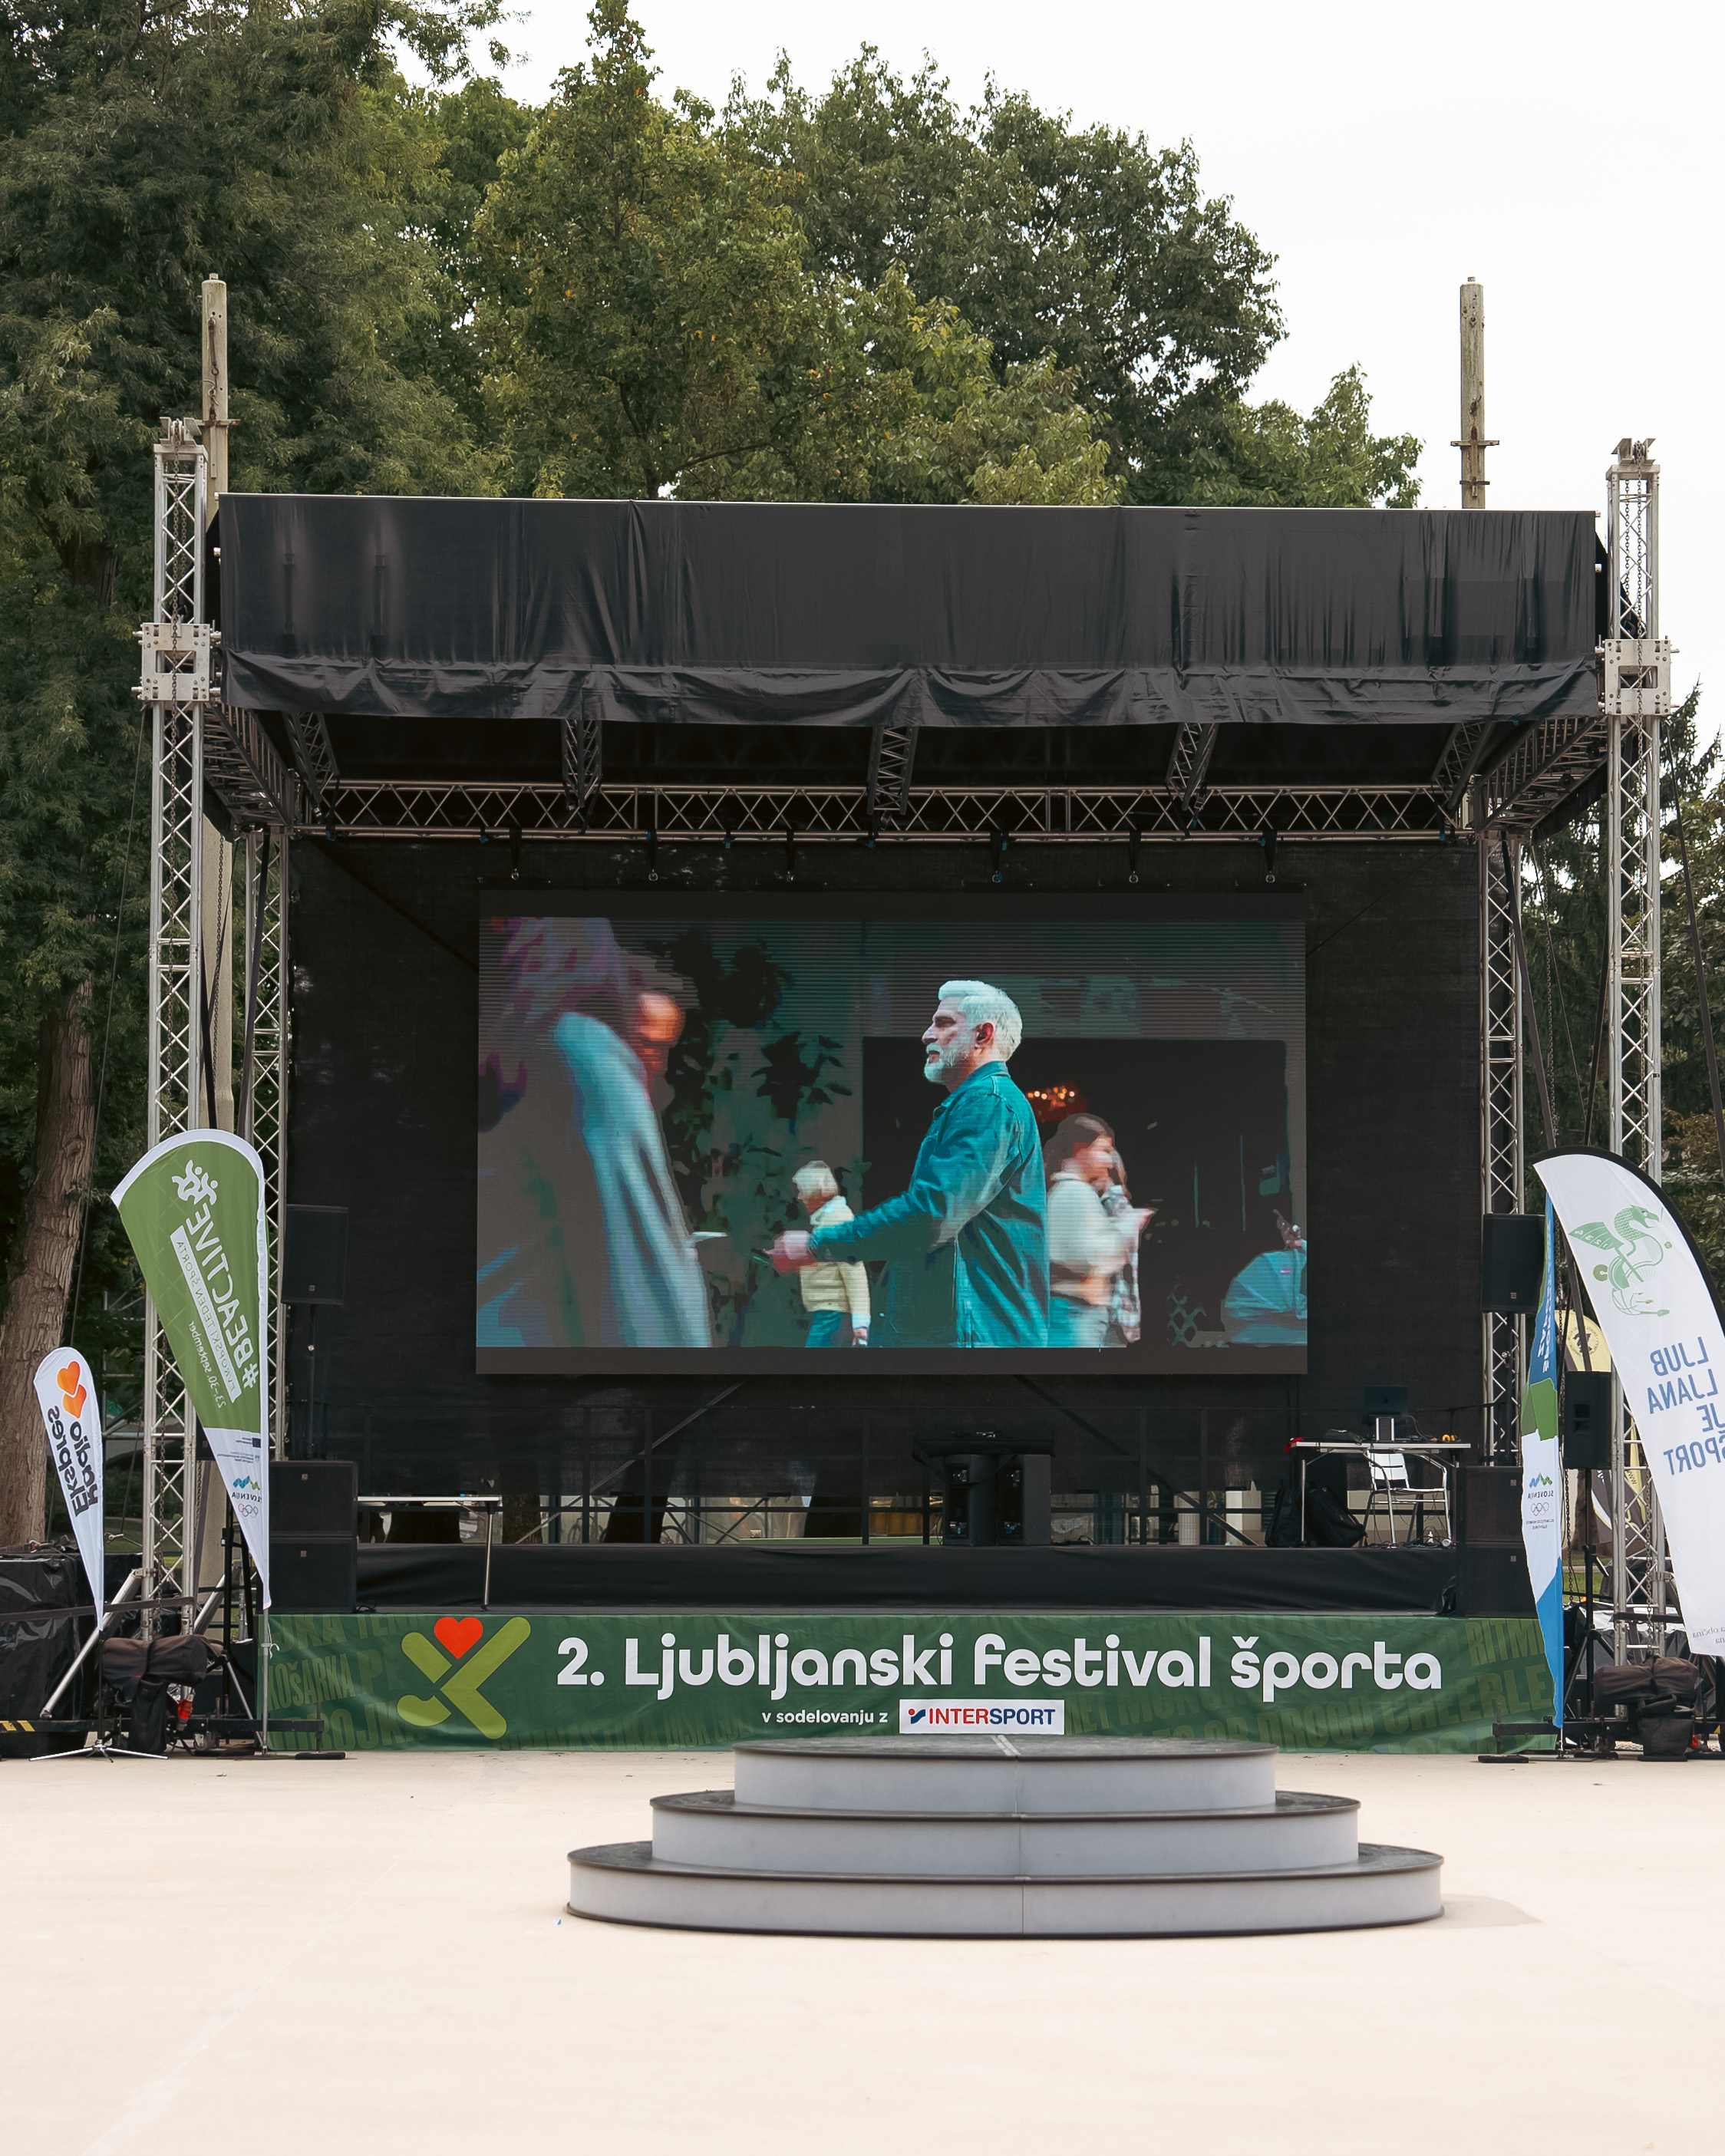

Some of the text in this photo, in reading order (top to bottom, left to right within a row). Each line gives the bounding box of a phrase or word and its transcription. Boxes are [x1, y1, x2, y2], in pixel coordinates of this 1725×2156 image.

[558, 1637, 604, 1686] 2.
[625, 1633, 953, 1699] Ljubljanski
[1231, 1637, 1441, 1702] športa
[761, 1709, 889, 1726] v sodelovanju z
[928, 1708, 1056, 1725] INTERSPORT
